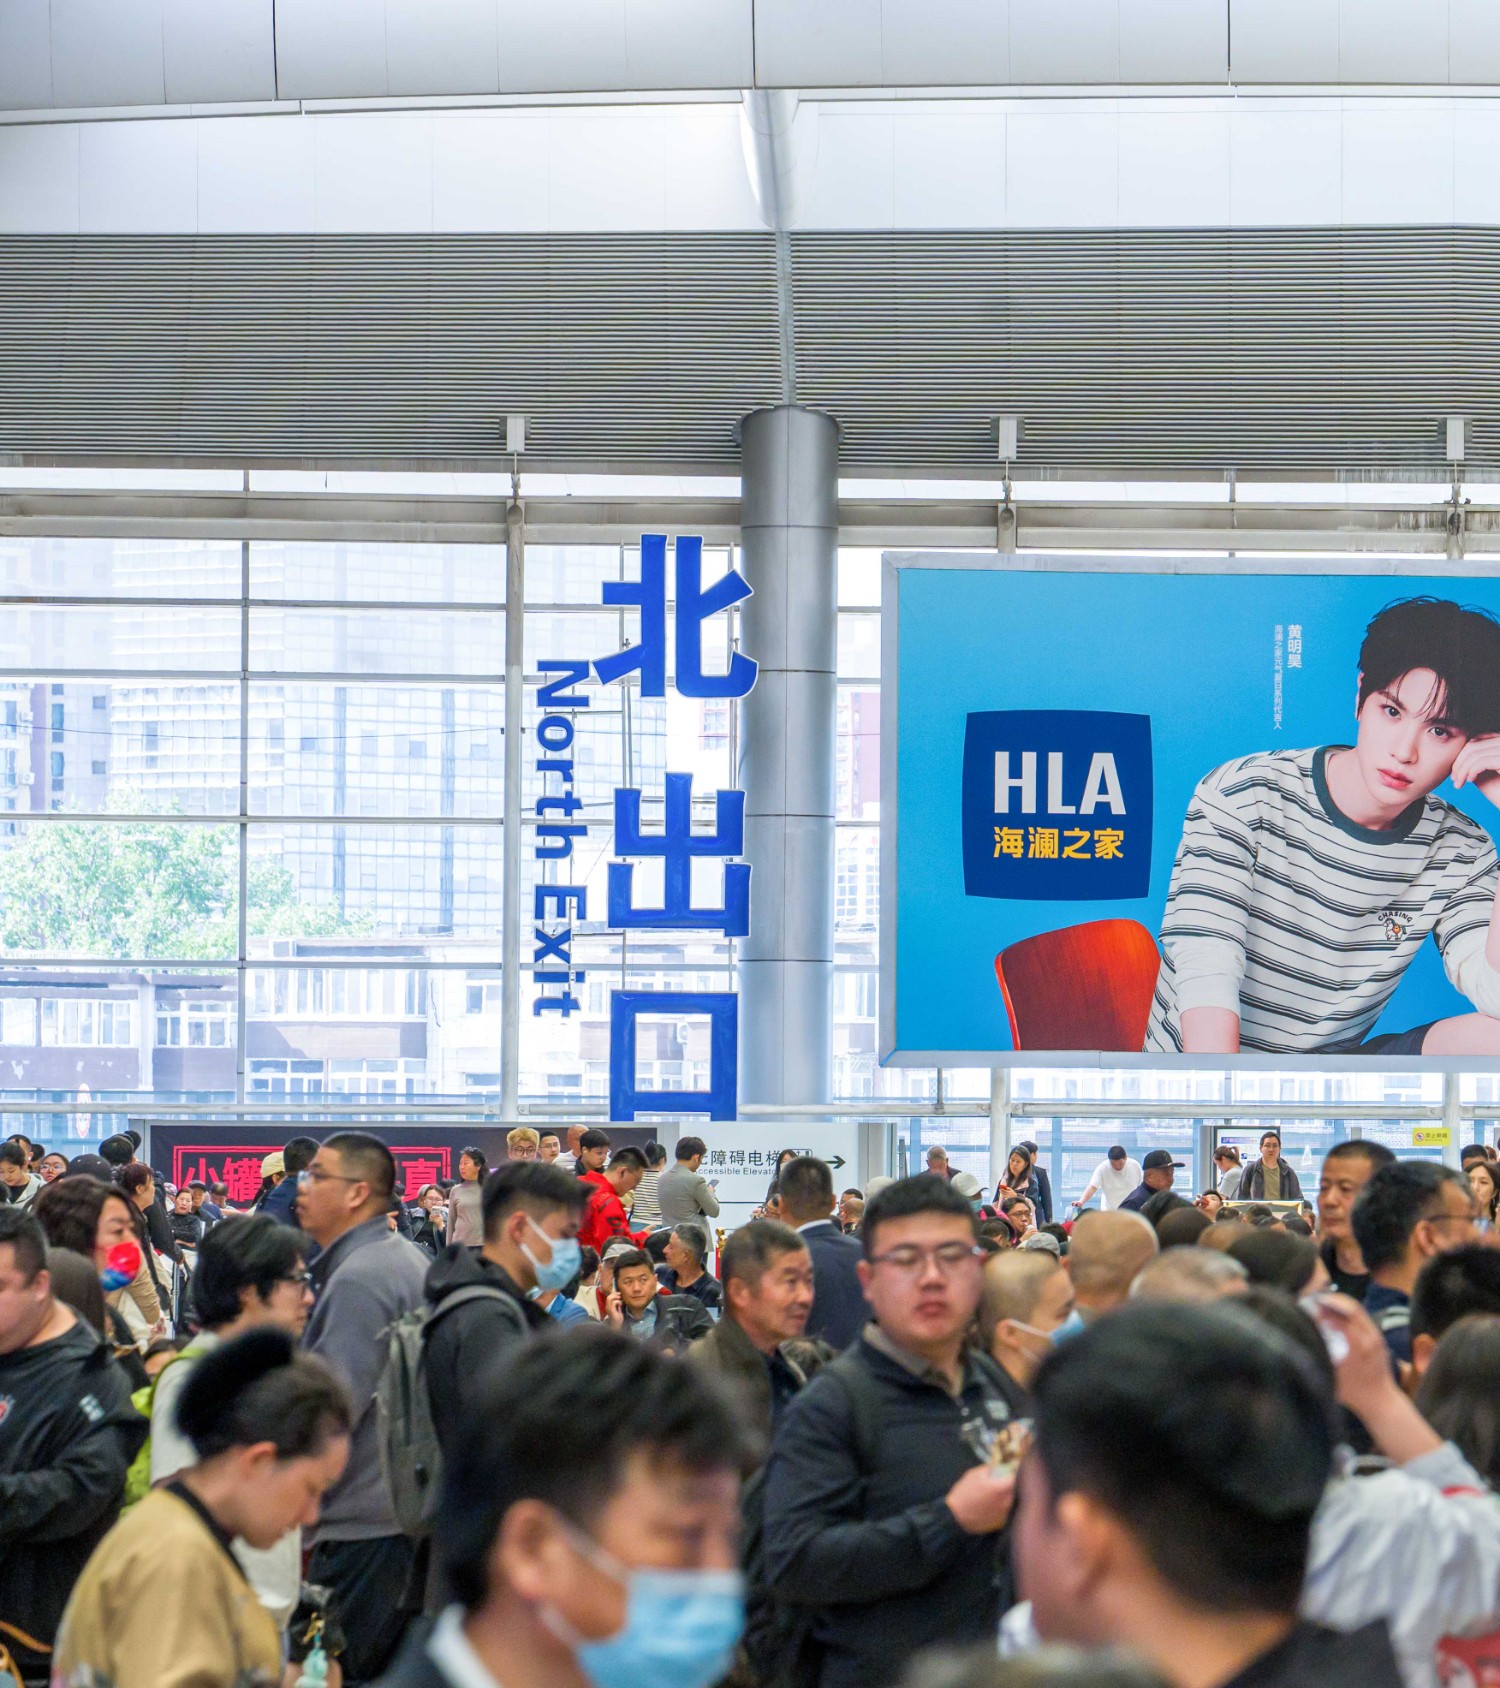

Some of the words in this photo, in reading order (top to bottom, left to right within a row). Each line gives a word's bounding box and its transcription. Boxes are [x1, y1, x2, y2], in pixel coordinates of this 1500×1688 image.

[1287, 624, 1302, 668] 黄明昊
[536, 660, 590, 859] North
[994, 751, 1127, 815] HLA
[592, 534, 758, 1121] 北出口
[993, 826, 1125, 860] 海澜之家
[1377, 911, 1413, 923] CHASING
[533, 884, 588, 1018] Exit
[696, 1167, 741, 1175] ccessible
